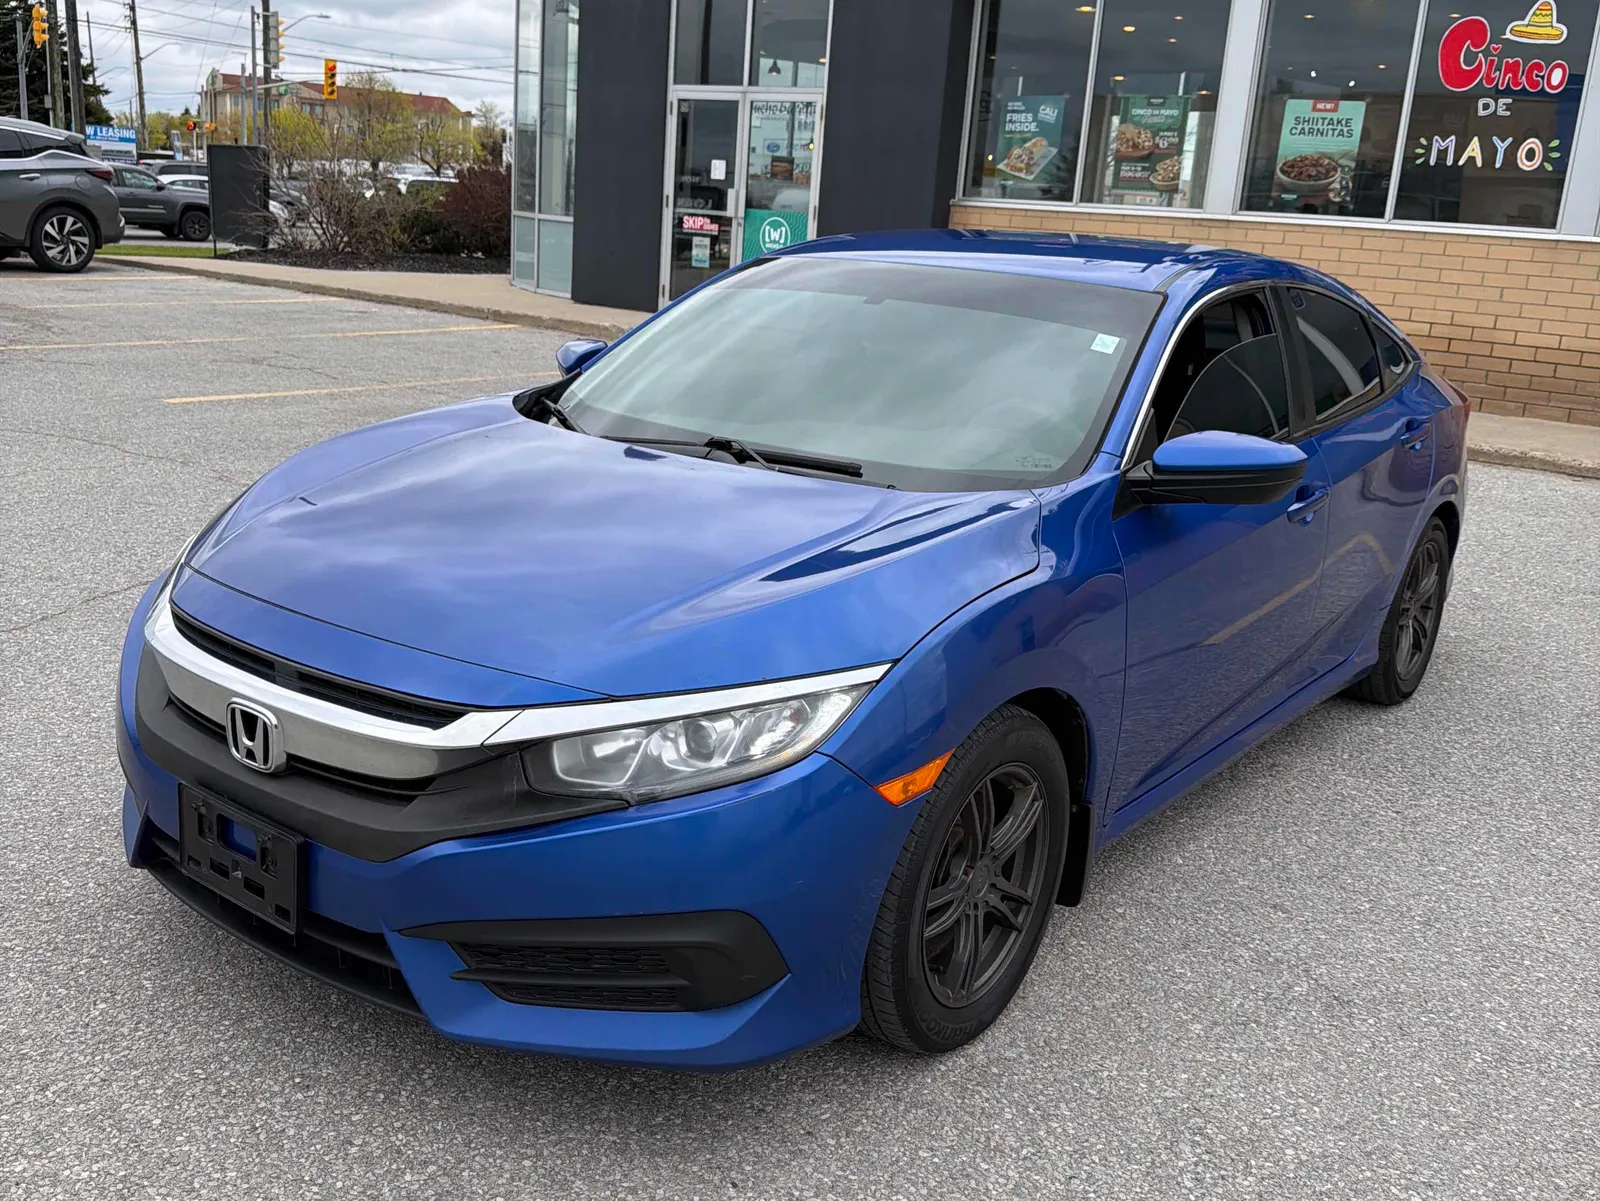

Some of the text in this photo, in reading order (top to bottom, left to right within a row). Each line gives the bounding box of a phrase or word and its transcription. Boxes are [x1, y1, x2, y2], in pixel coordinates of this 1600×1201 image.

[1438, 16, 1568, 93] Cinco
[1477, 98, 1513, 116] DE
[1006, 113, 1033, 122] FRIES
[1293, 116, 1354, 128] SHIITAKE
[97, 126, 136, 139] LEASING
[1005, 122, 1040, 132] INSIDE.
[1289, 126, 1354, 139] CARNITAS
[1429, 135, 1543, 171] MAYO
[682, 215, 704, 229] SKIP
